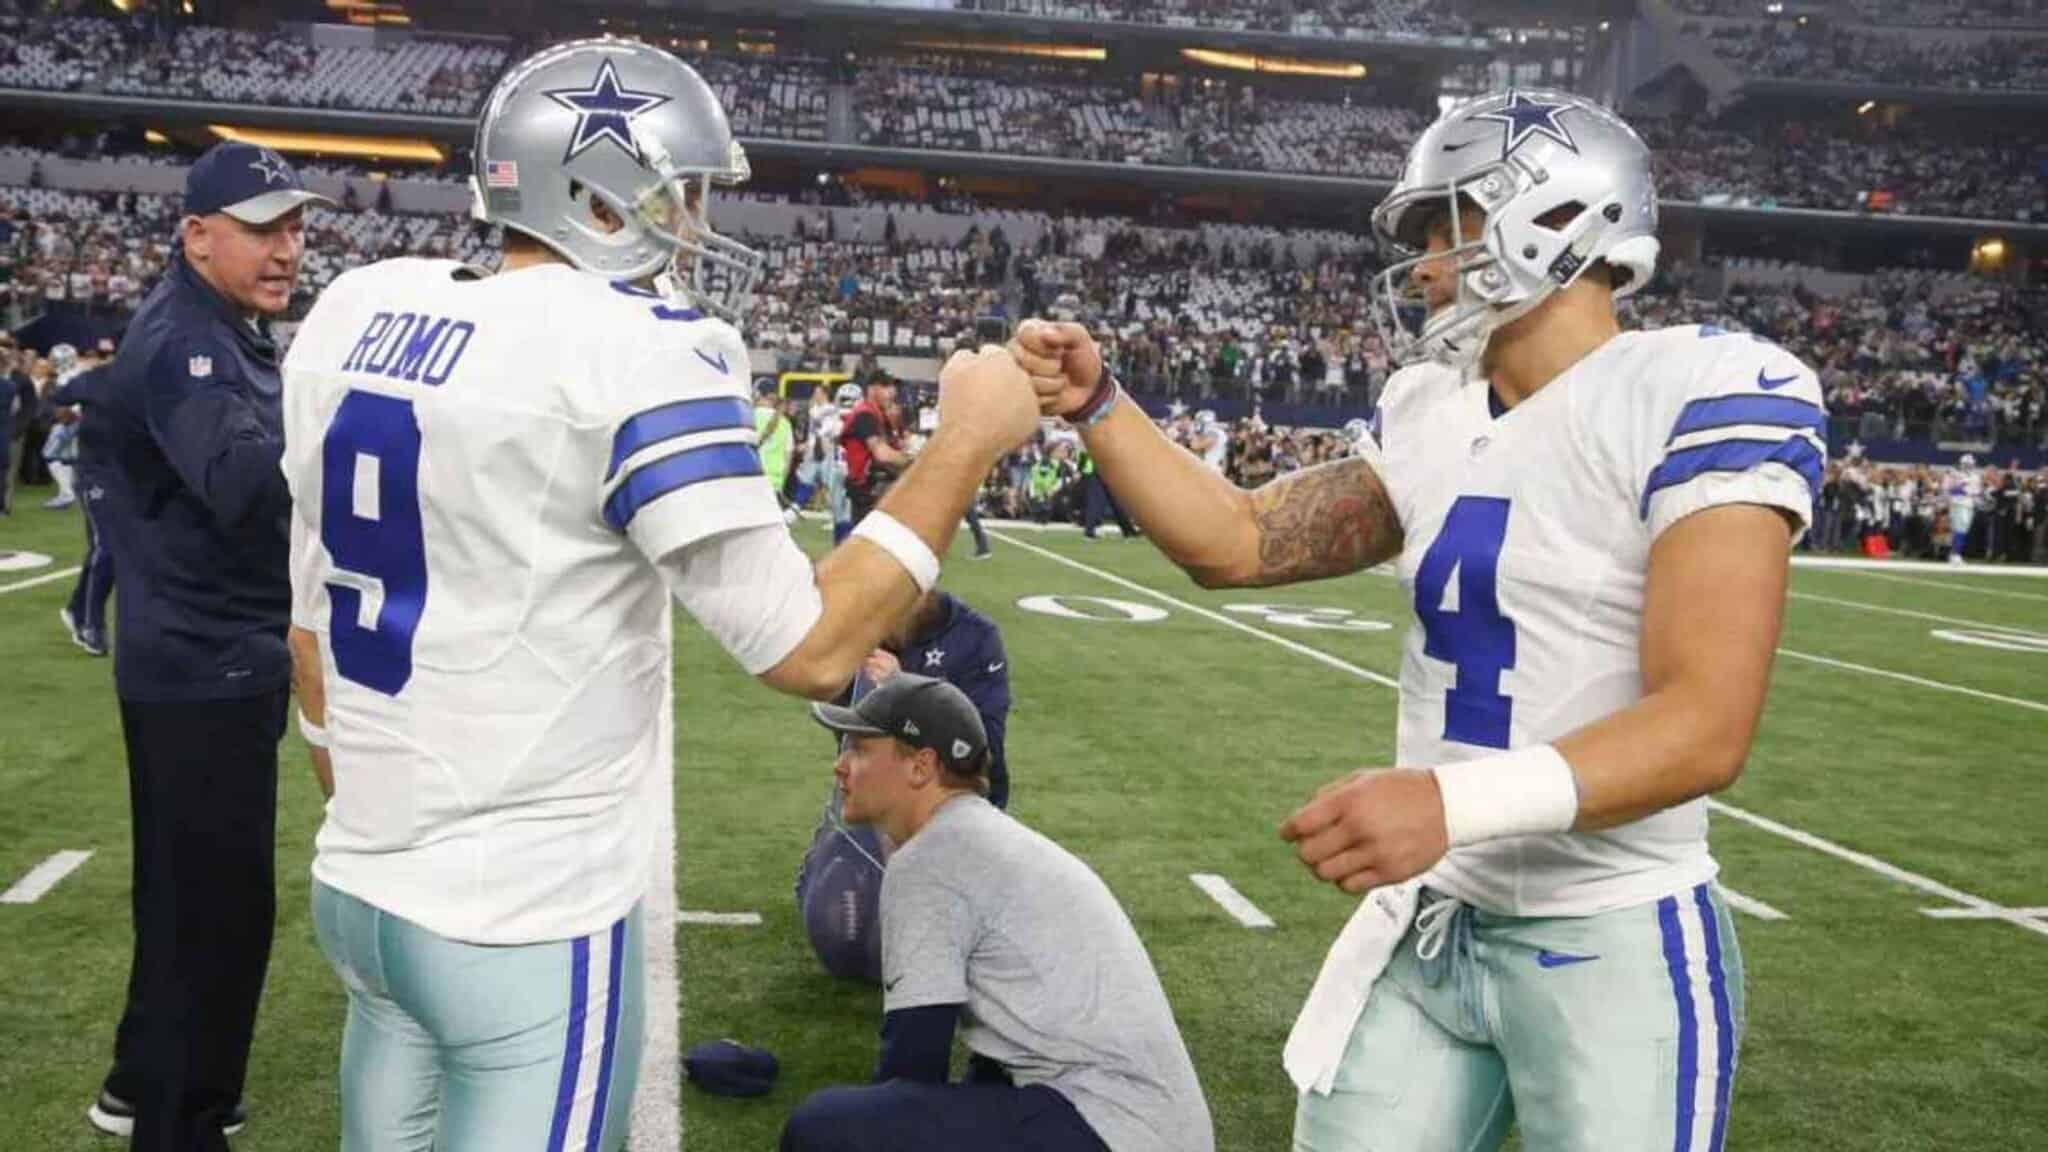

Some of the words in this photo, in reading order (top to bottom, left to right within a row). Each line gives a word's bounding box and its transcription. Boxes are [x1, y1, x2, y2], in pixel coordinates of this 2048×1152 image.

[341, 311, 475, 387] ROMO
[321, 388, 428, 697] 9
[1414, 495, 1516, 750] 4
